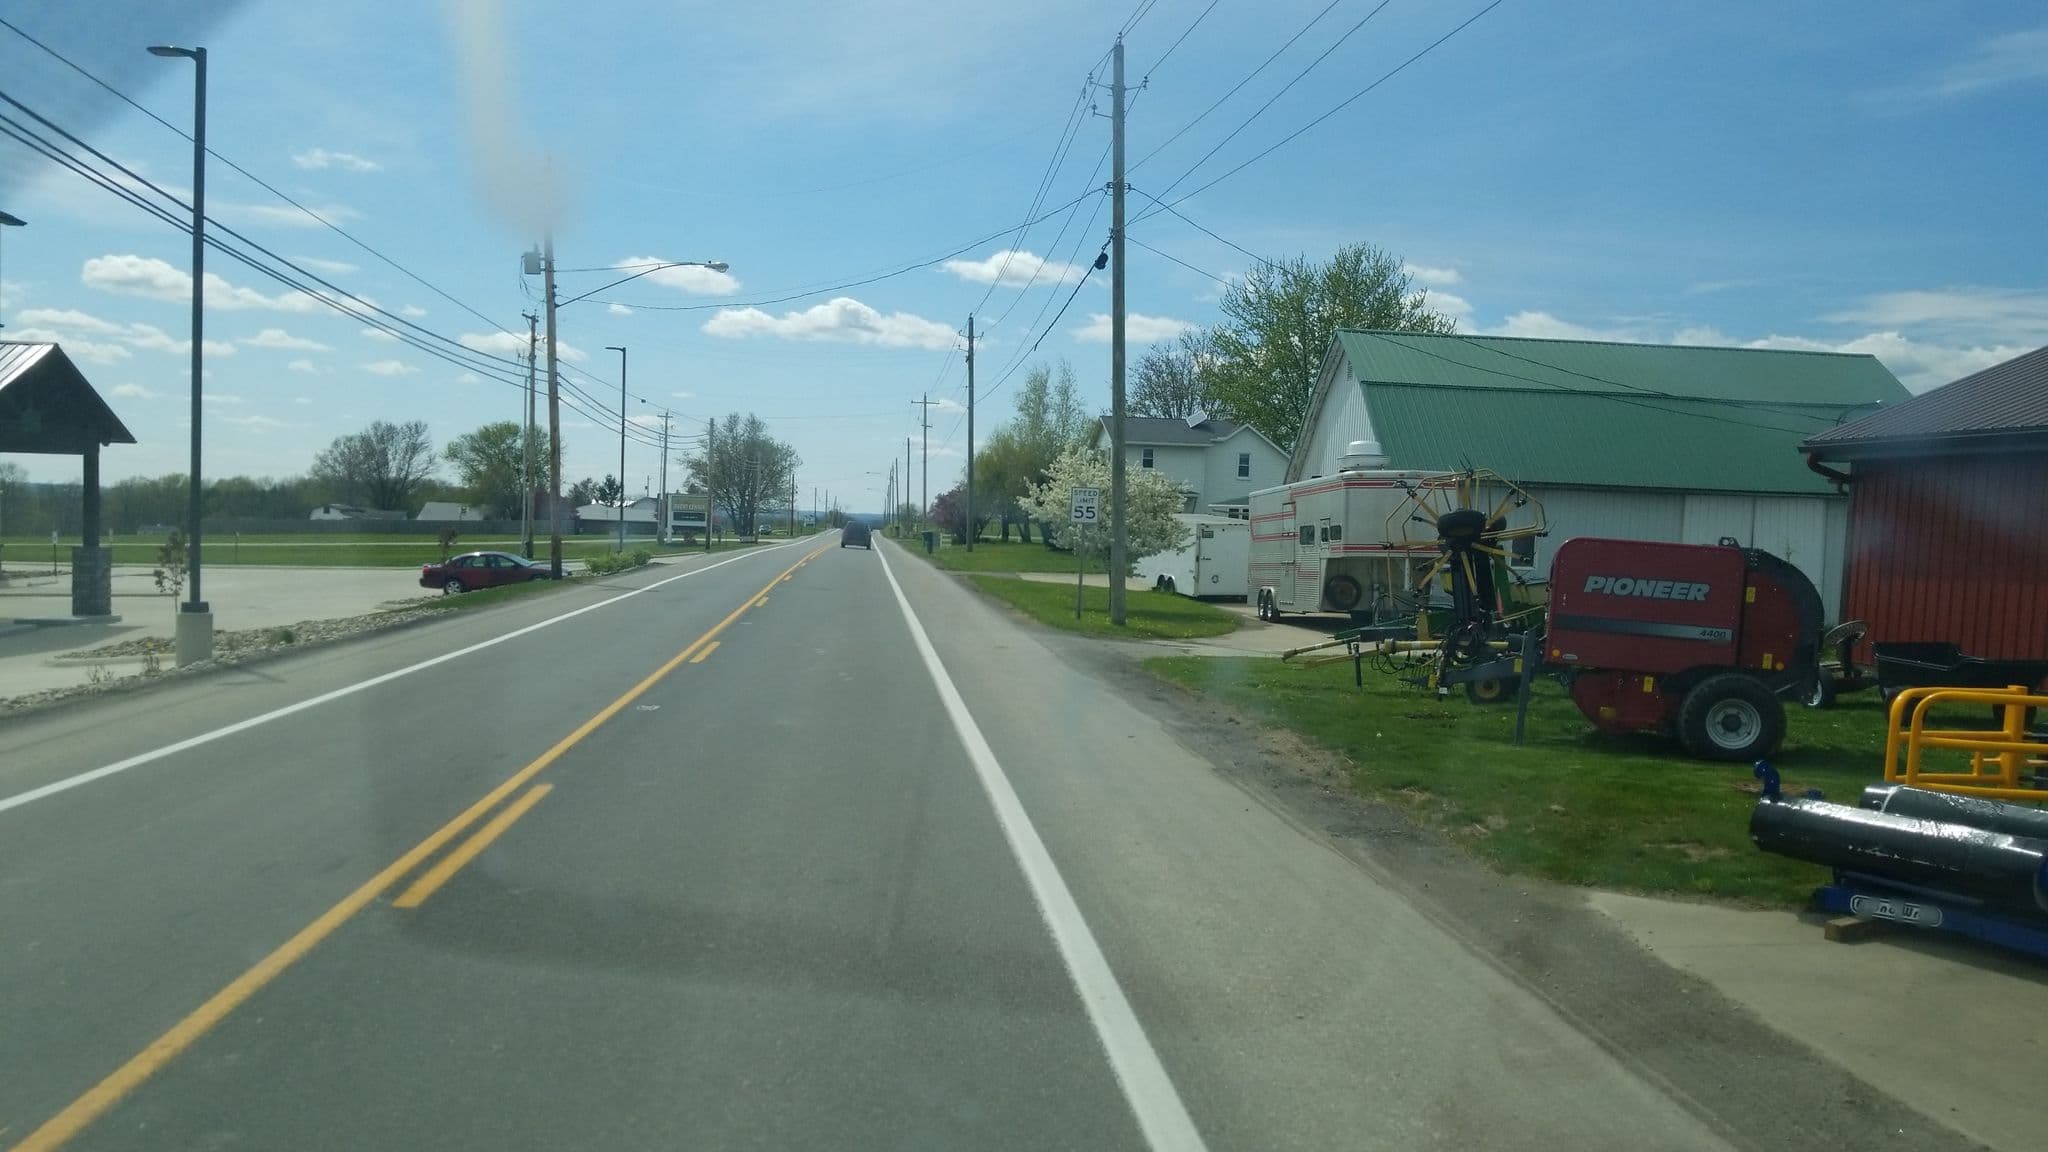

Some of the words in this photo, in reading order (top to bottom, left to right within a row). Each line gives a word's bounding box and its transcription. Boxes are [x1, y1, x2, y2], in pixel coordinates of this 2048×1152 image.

[1074, 506, 1096, 519] 55
[1583, 575, 1711, 601] PIONEER
[1699, 629, 1727, 639] 4400
